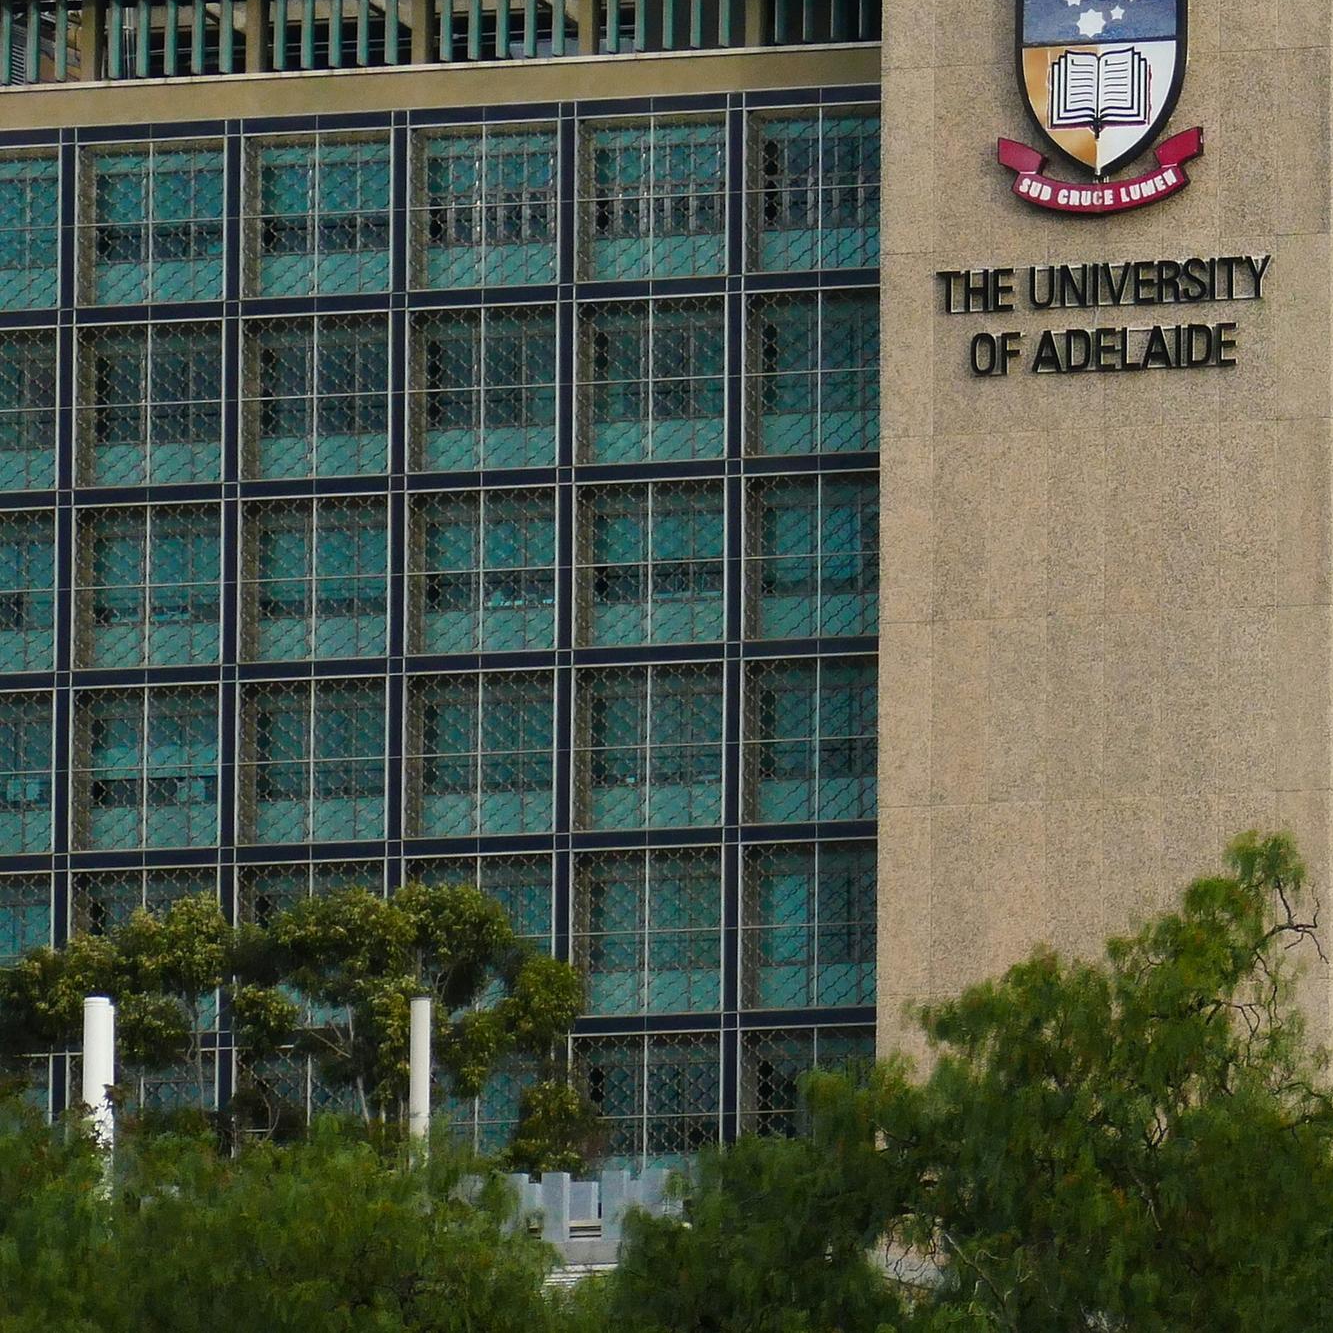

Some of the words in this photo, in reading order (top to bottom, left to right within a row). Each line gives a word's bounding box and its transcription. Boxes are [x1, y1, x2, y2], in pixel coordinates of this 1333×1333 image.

[1057, 188, 1114, 206] CRUCE
[1120, 168, 1178, 203] LUMEN
[936, 267, 1016, 314] THE
[1028, 254, 1272, 309] UNIVERSITY
[970, 330, 1024, 377] OF
[1031, 322, 1239, 373] ADELAIDE
